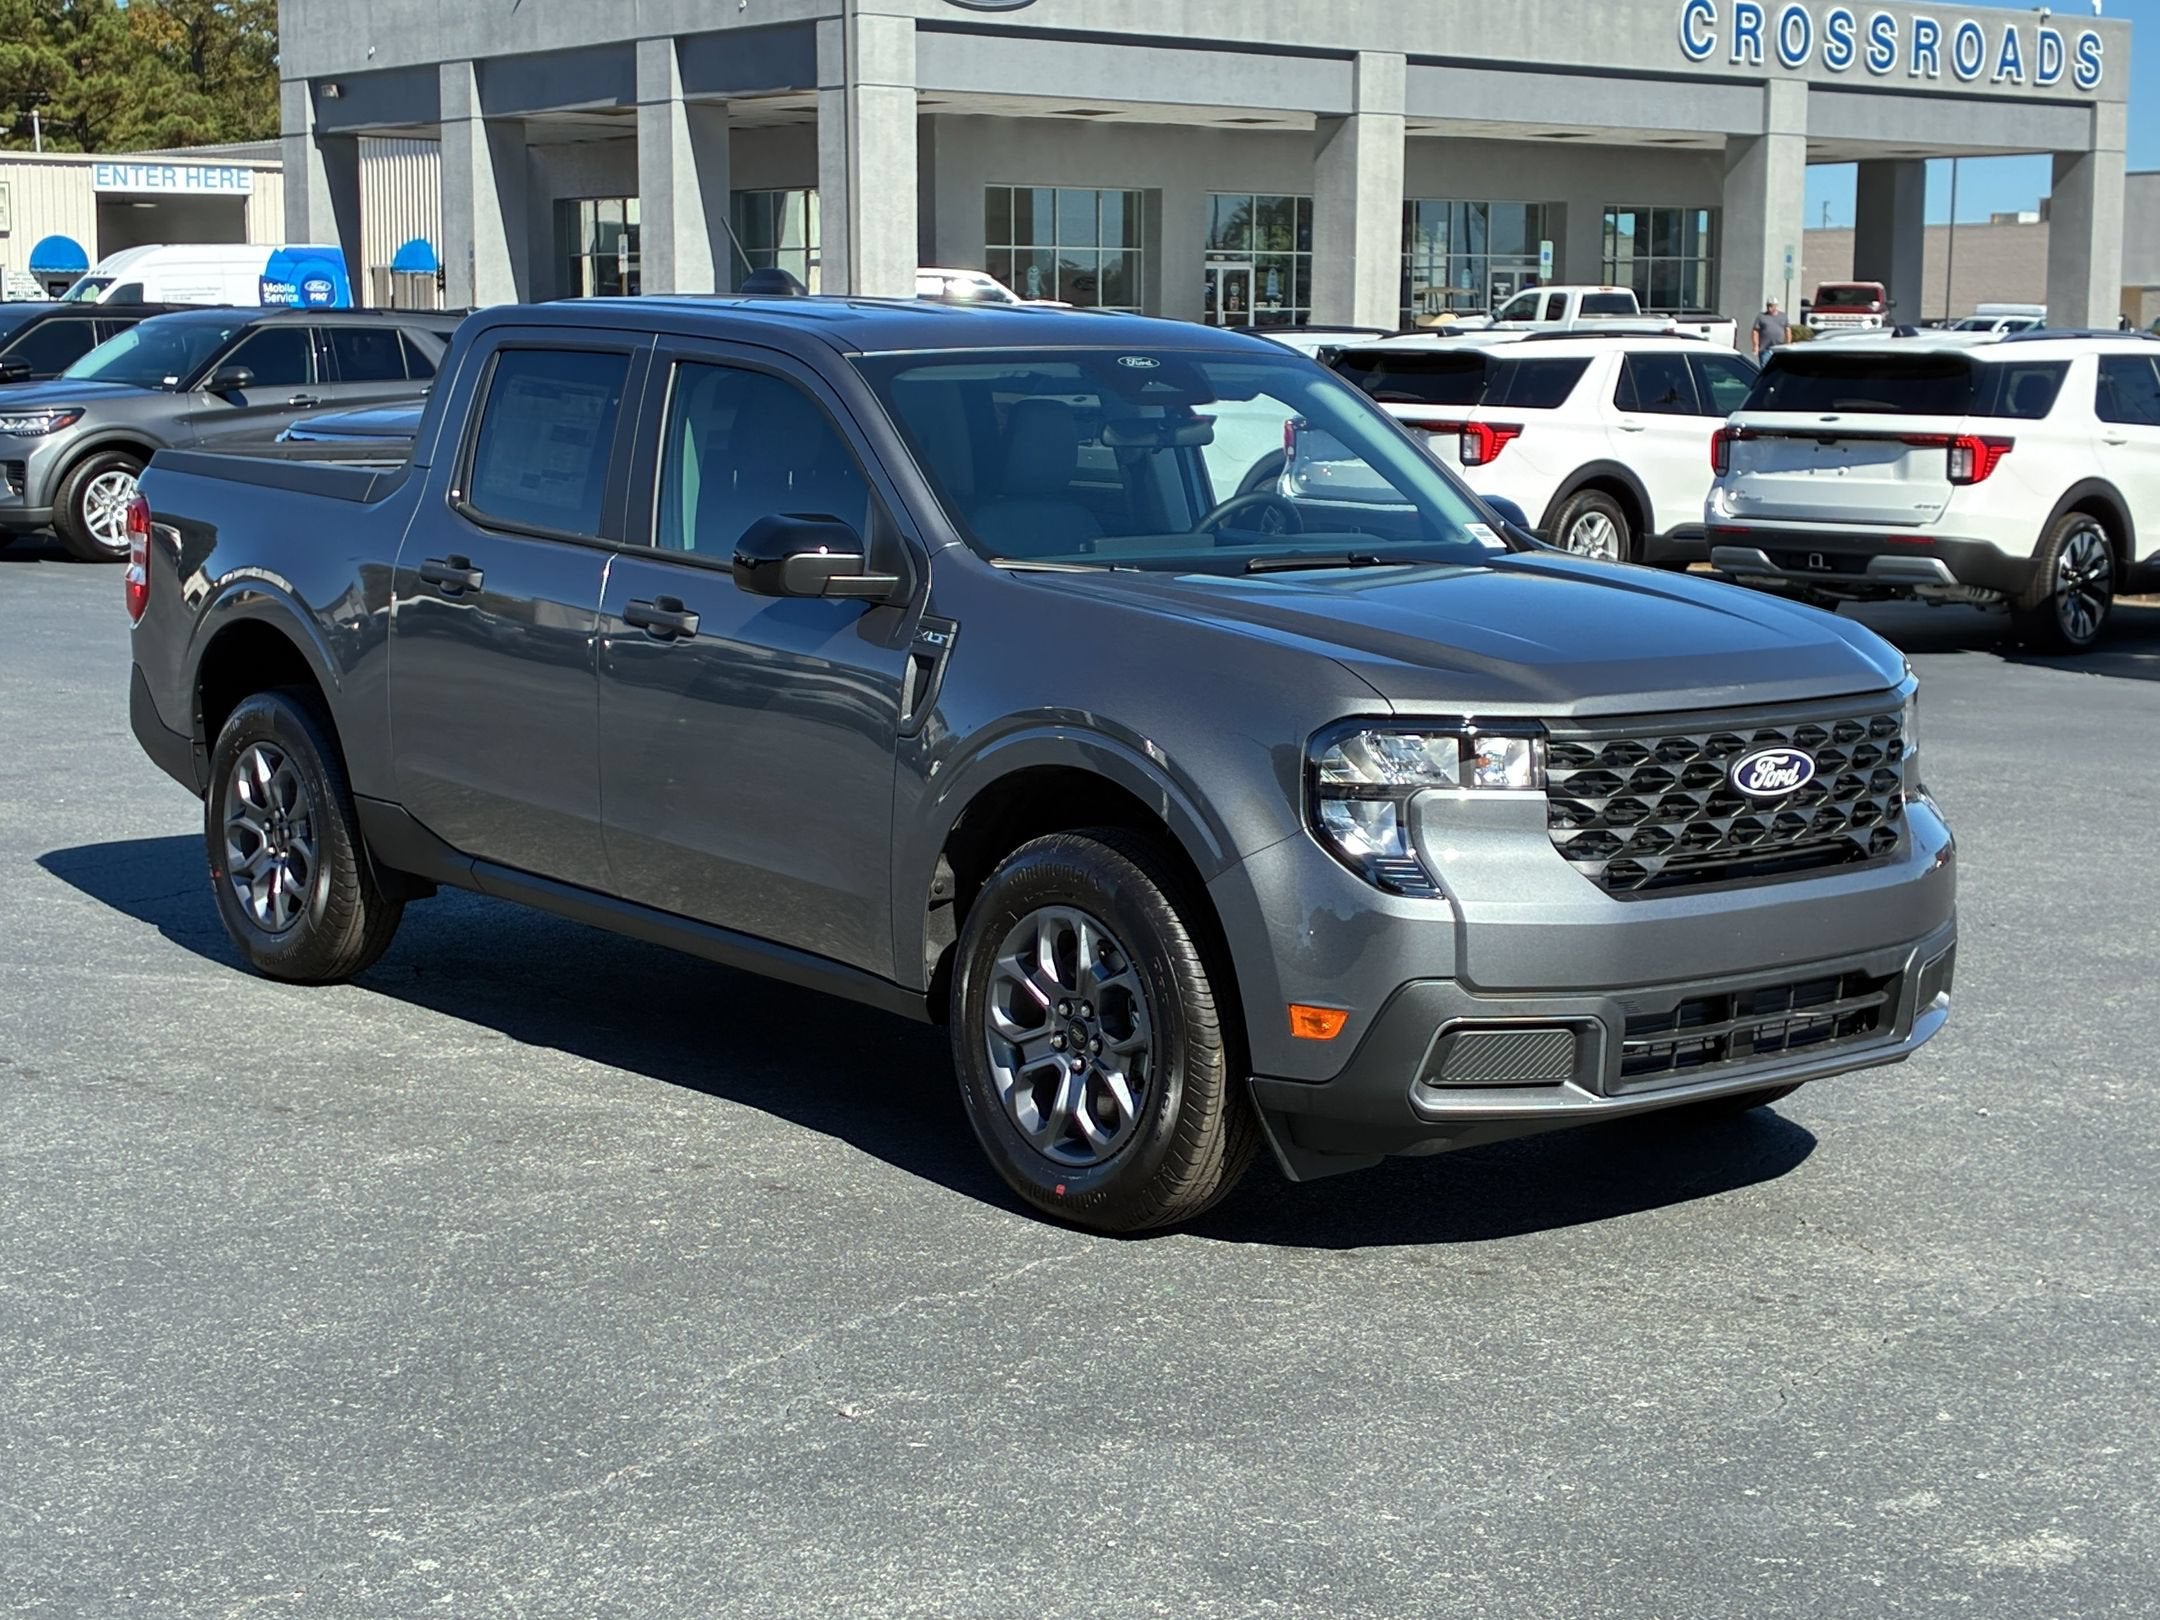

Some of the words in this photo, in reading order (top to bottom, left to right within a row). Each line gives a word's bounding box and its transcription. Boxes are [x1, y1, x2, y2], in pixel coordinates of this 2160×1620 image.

[1680, 0, 2105, 90] CROSSROADS
[96, 164, 176, 187] ENTER
[186, 167, 250, 189] HERE
[263, 282, 297, 293] Mobile
[264, 292, 299, 303] Service
[310, 292, 327, 301] PRO
[913, 629, 949, 645] XLT
[1749, 755, 1801, 789] Ford
